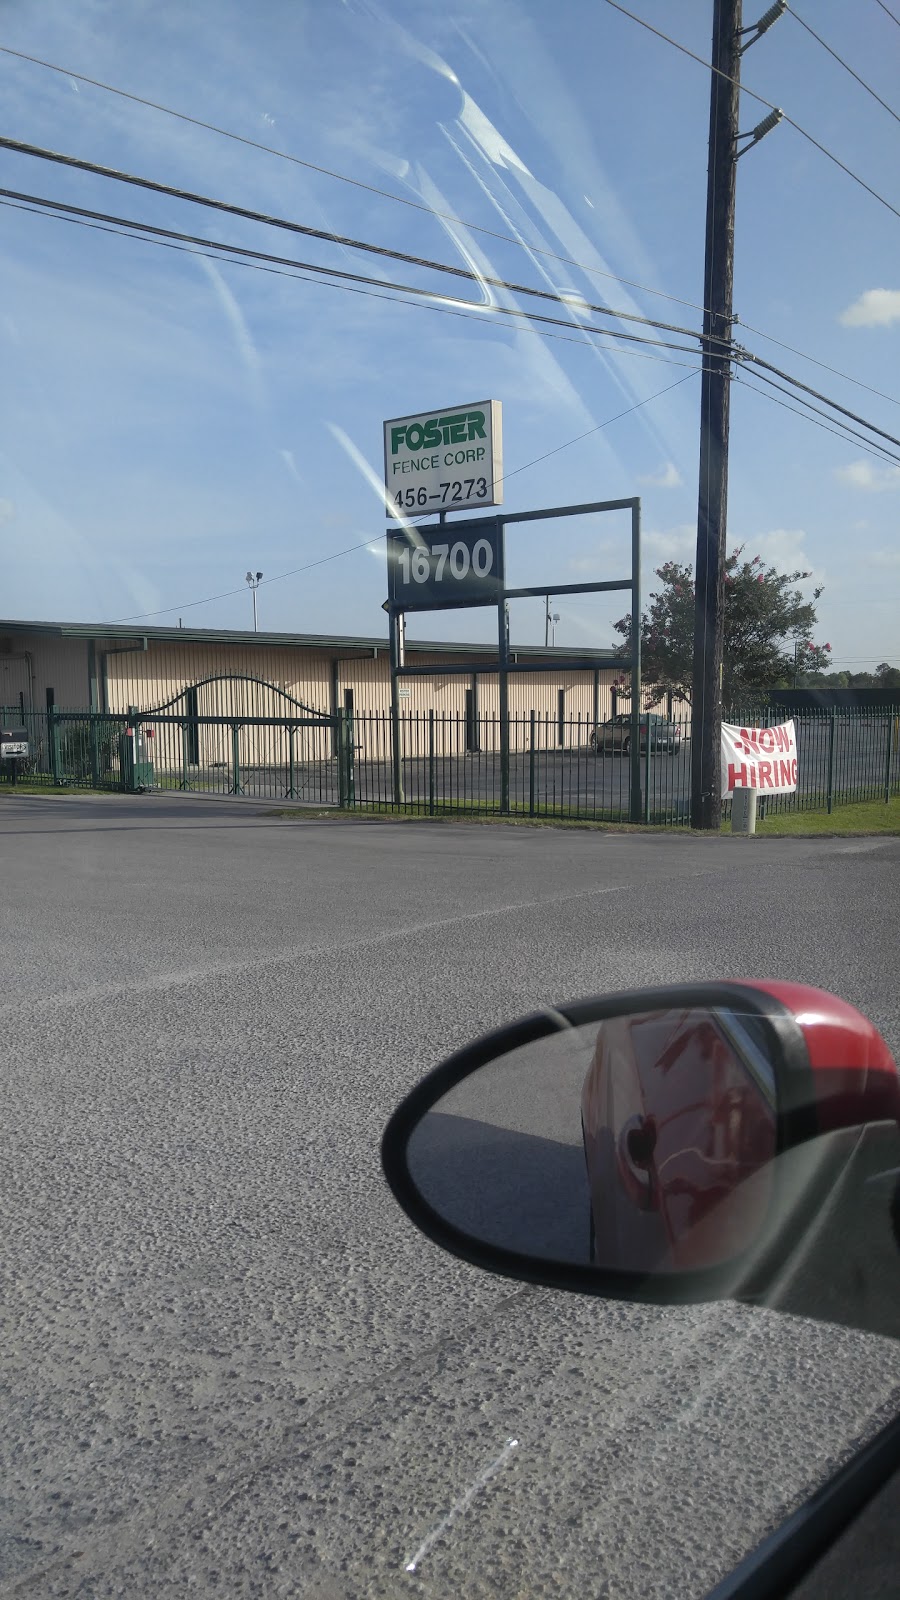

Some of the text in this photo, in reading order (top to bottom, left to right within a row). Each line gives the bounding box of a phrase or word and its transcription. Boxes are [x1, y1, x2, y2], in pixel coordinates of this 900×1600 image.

[391, 410, 487, 455] FOSTER
[393, 447, 486, 475] FENCE CORP.
[393, 477, 488, 509] 456-7273
[398, 538, 494, 585] 16700
[727, 758, 798, 791] HIRING
